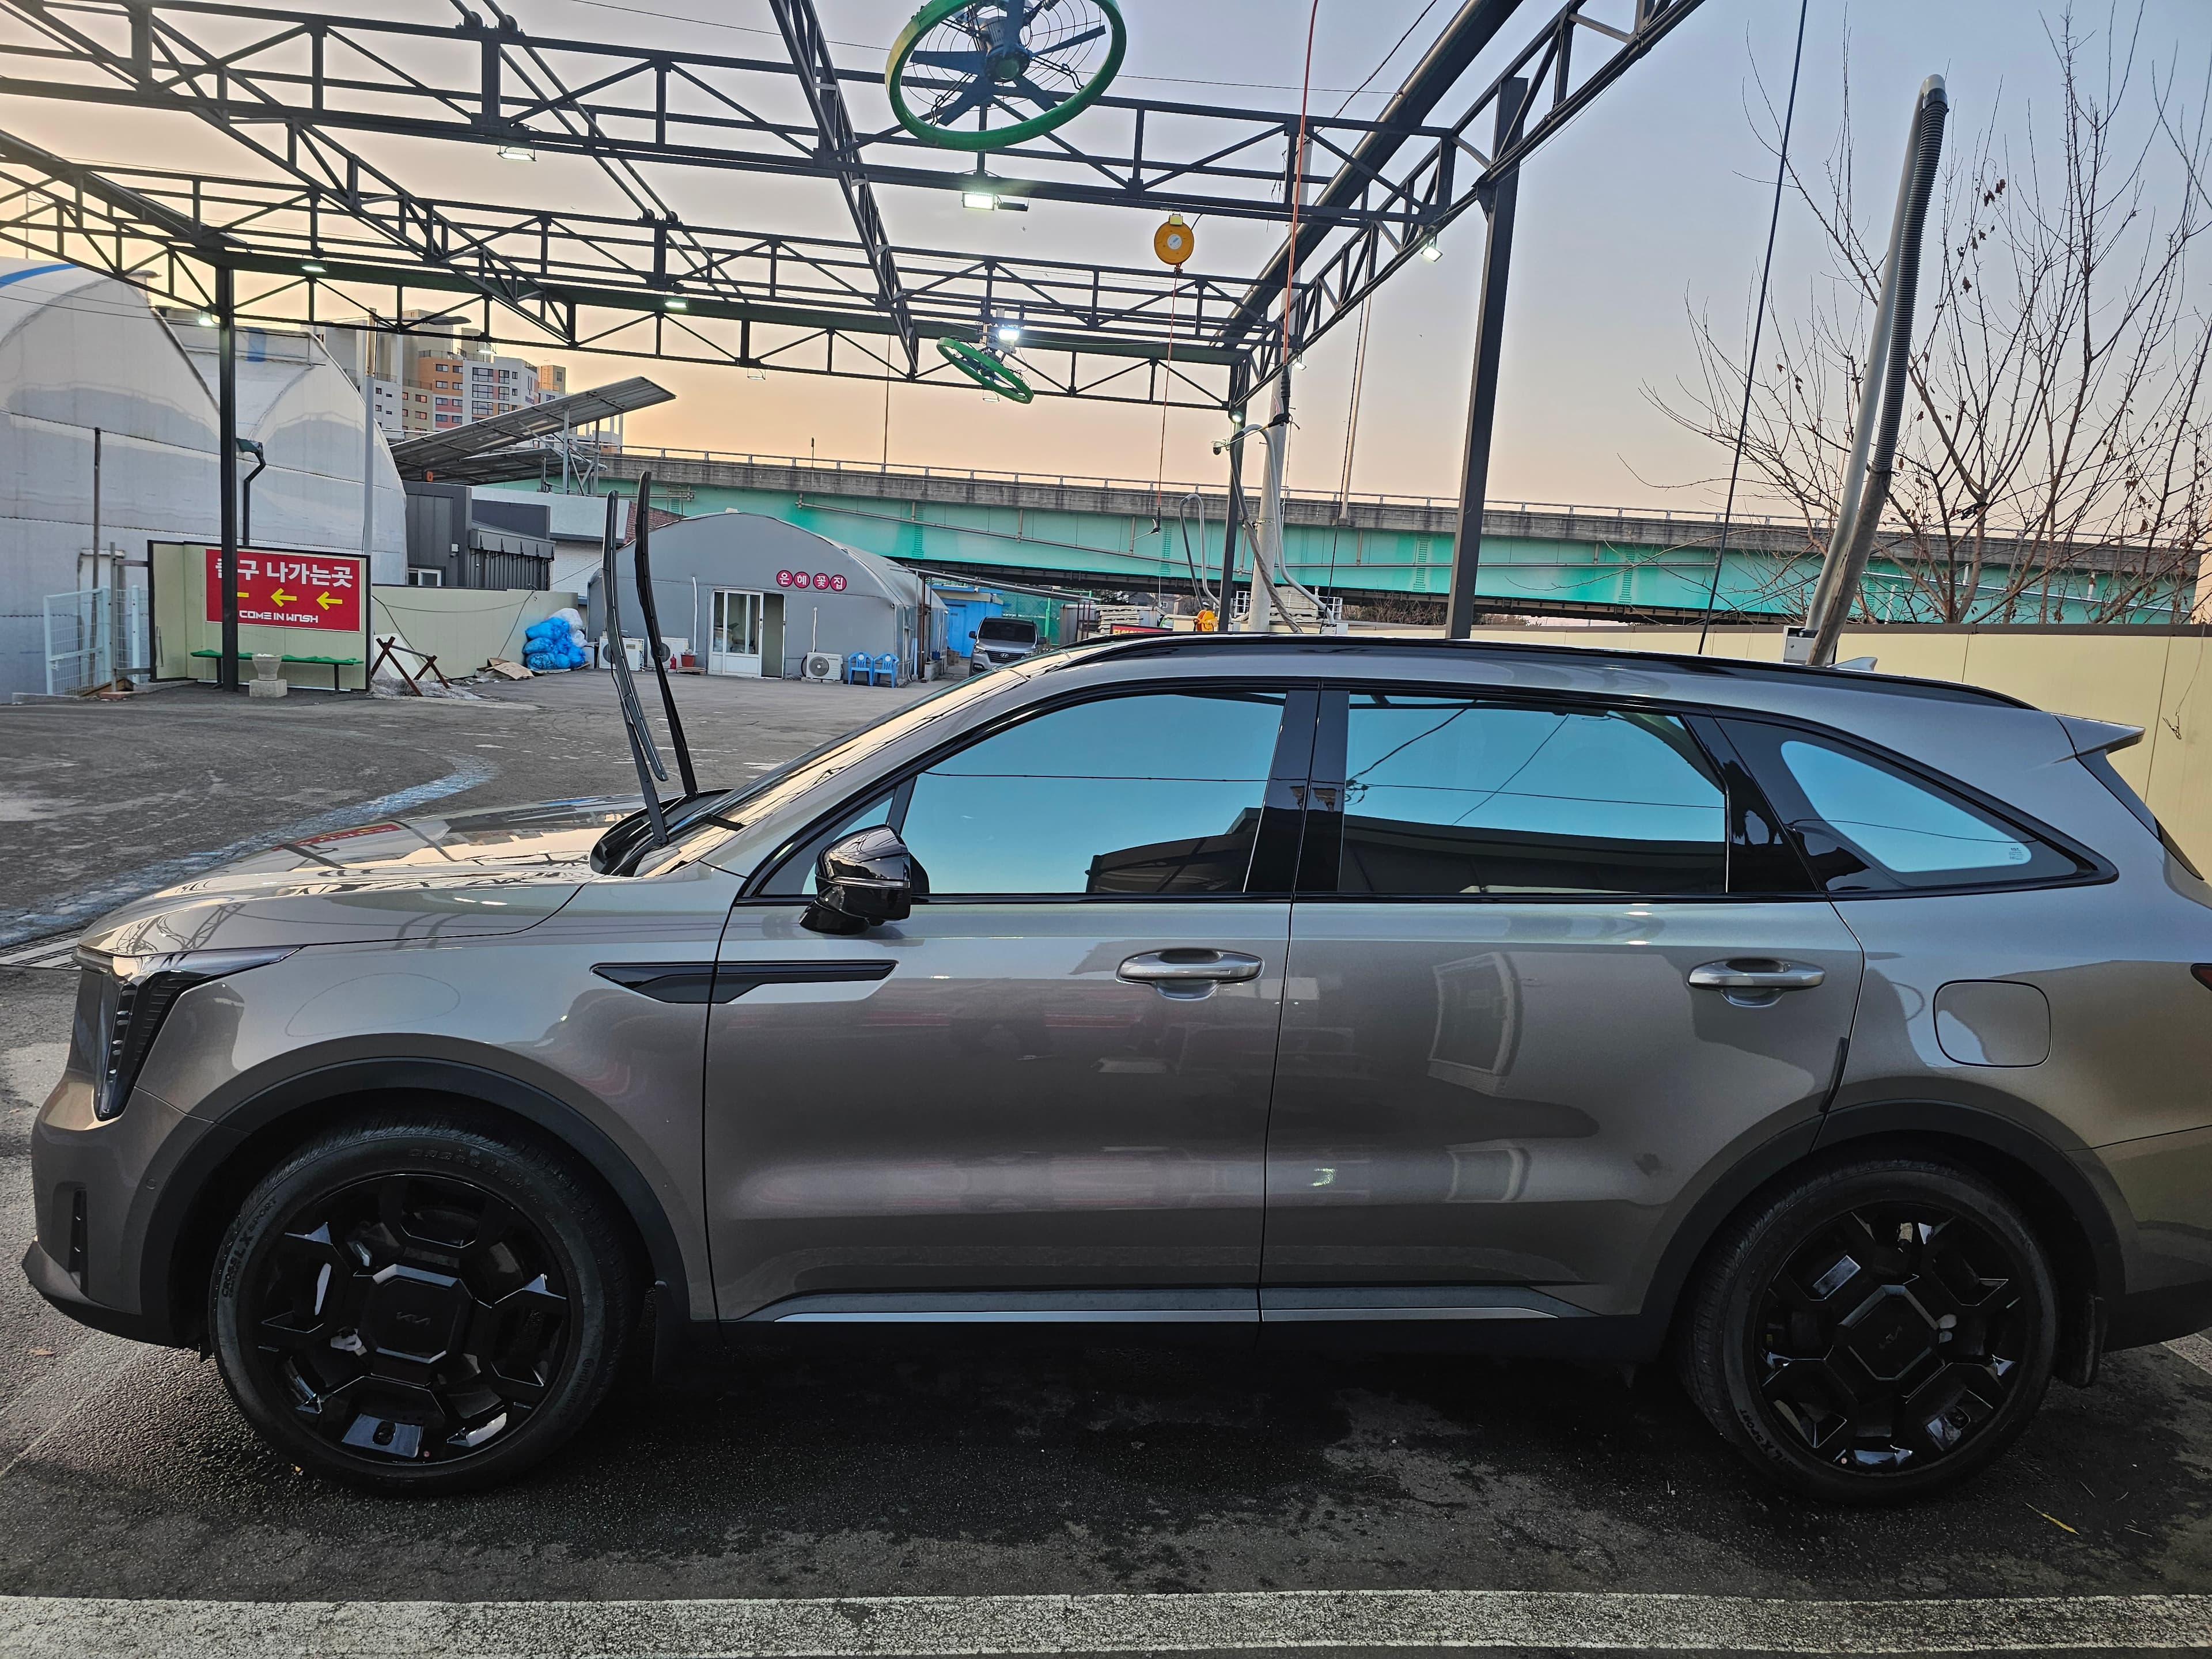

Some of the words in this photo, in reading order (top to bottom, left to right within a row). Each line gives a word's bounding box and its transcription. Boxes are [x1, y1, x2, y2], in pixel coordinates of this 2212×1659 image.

[267, 562, 353, 588] 나가는곳
[779, 572, 807, 586] 은혜
[816, 575, 844, 590] 꽃집
[239, 610, 272, 620] COME
[274, 612, 285, 620] IN
